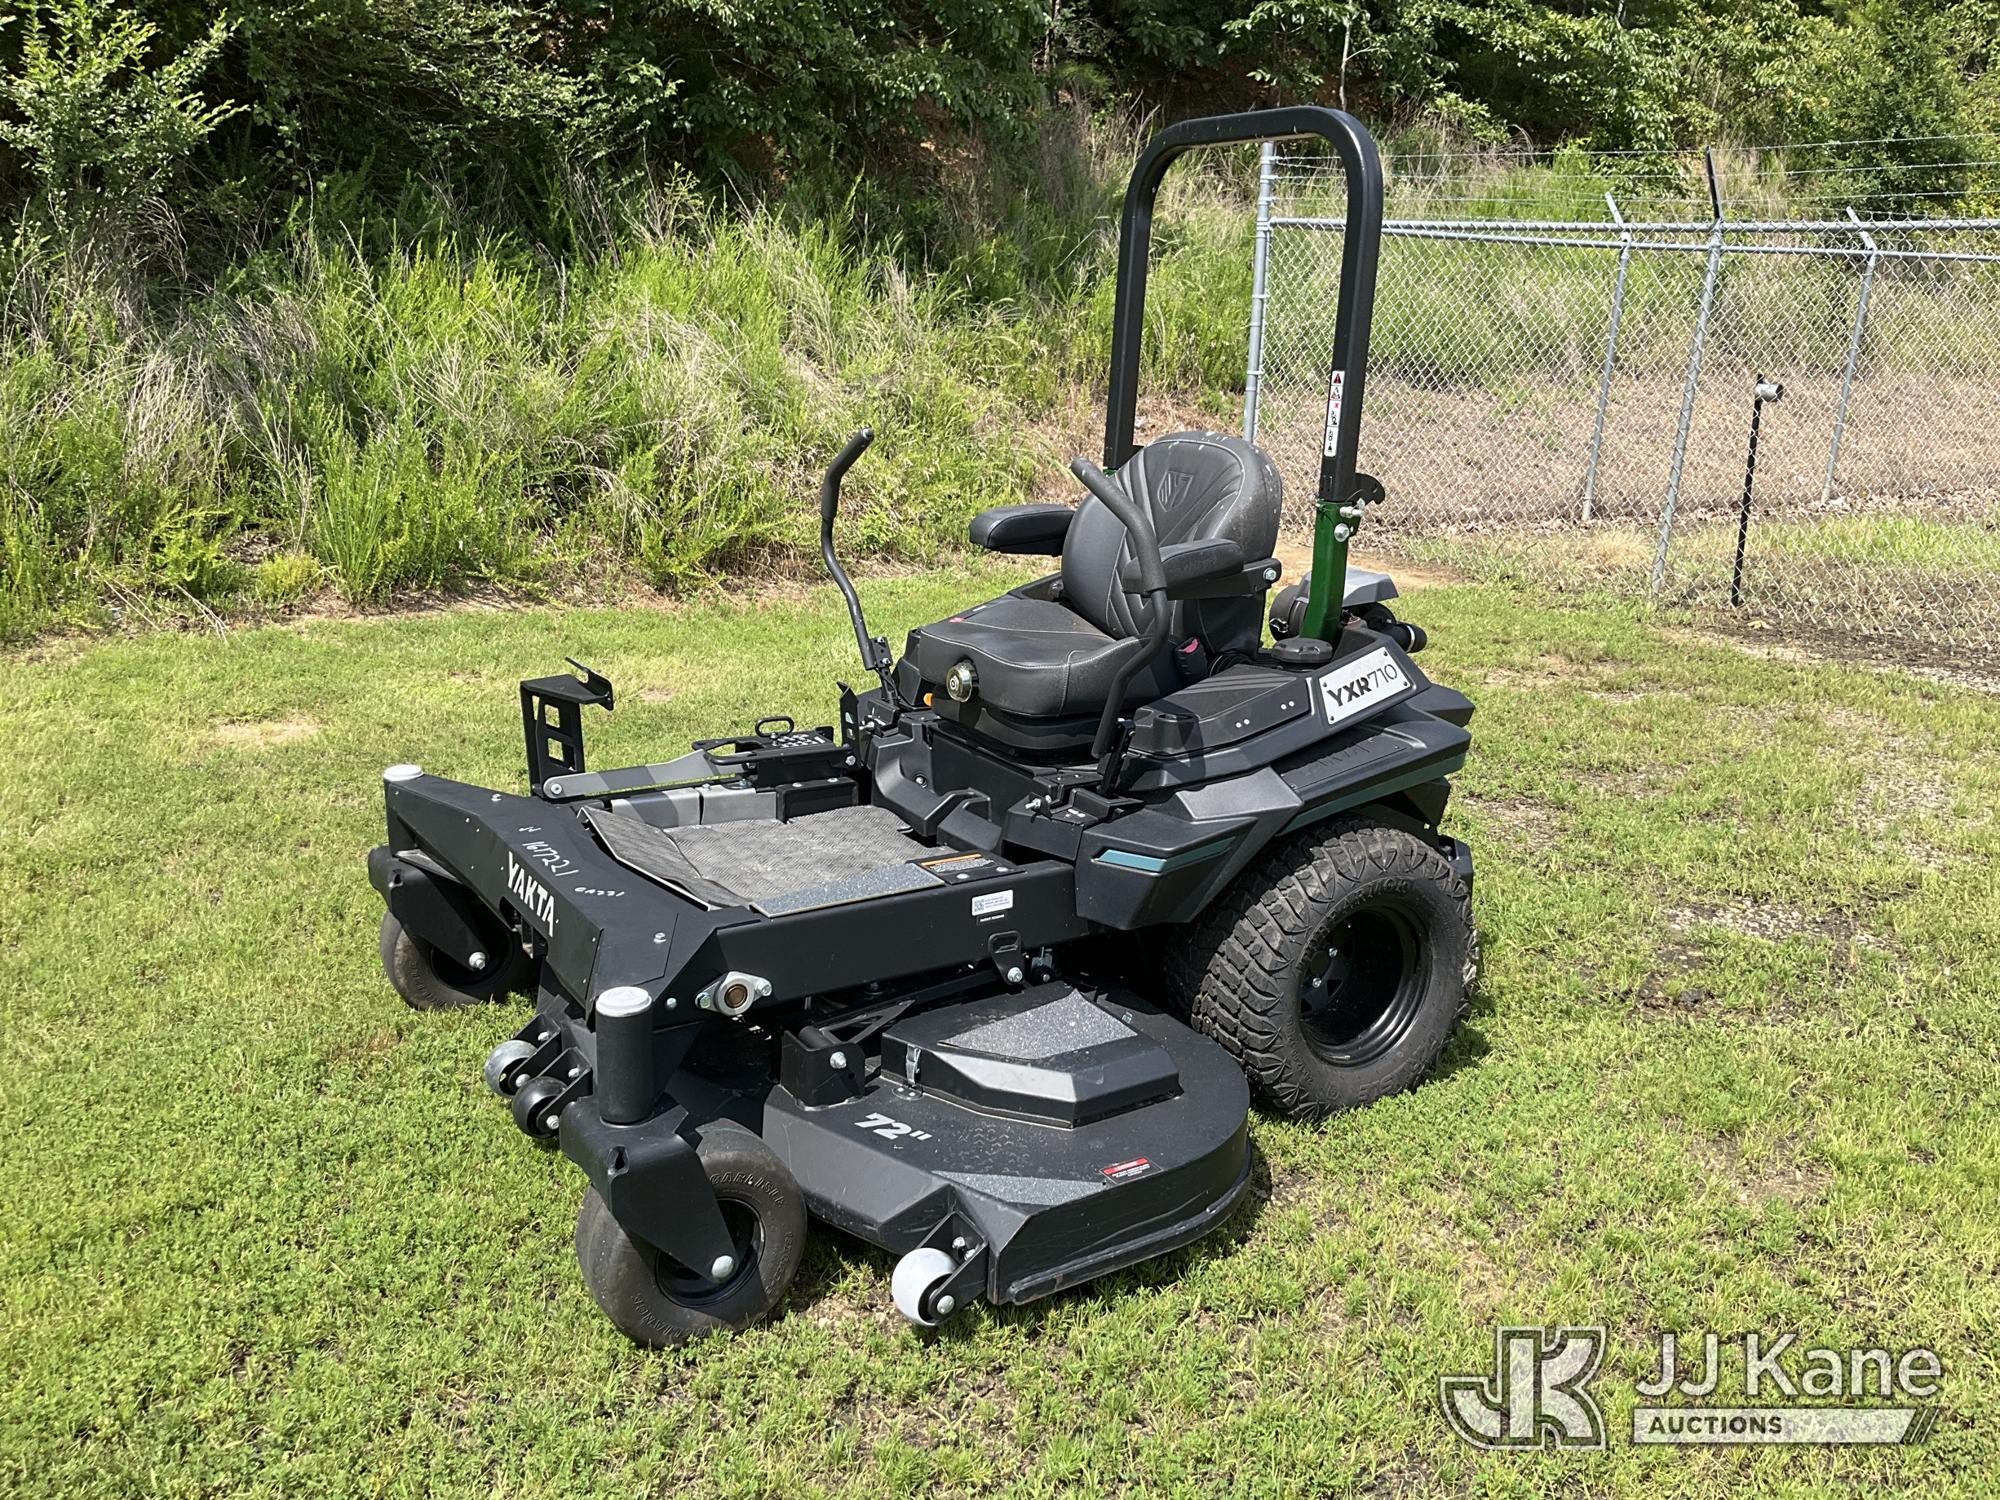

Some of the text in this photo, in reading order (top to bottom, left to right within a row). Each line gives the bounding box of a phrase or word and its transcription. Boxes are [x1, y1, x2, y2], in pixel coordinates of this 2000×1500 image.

[1327, 664, 1398, 707] YXR710
[507, 851, 555, 937] YAKTA
[854, 1112, 933, 1141] 72"
